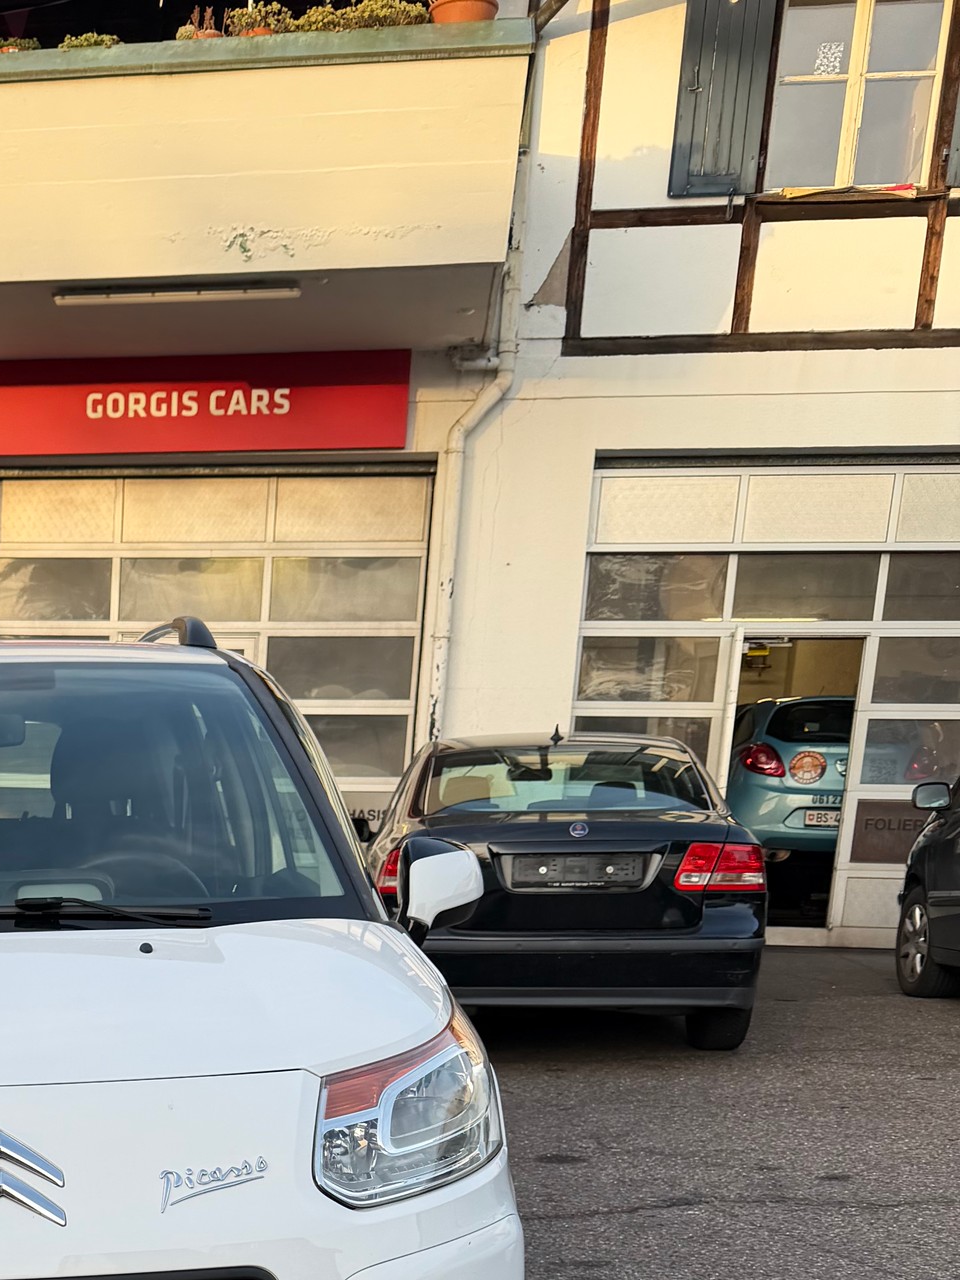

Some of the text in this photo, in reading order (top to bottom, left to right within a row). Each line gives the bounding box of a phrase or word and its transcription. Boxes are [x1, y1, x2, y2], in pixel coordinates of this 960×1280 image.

[86, 388, 291, 419] GORGIS CARS
[159, 1155, 268, 1214] Picasso
